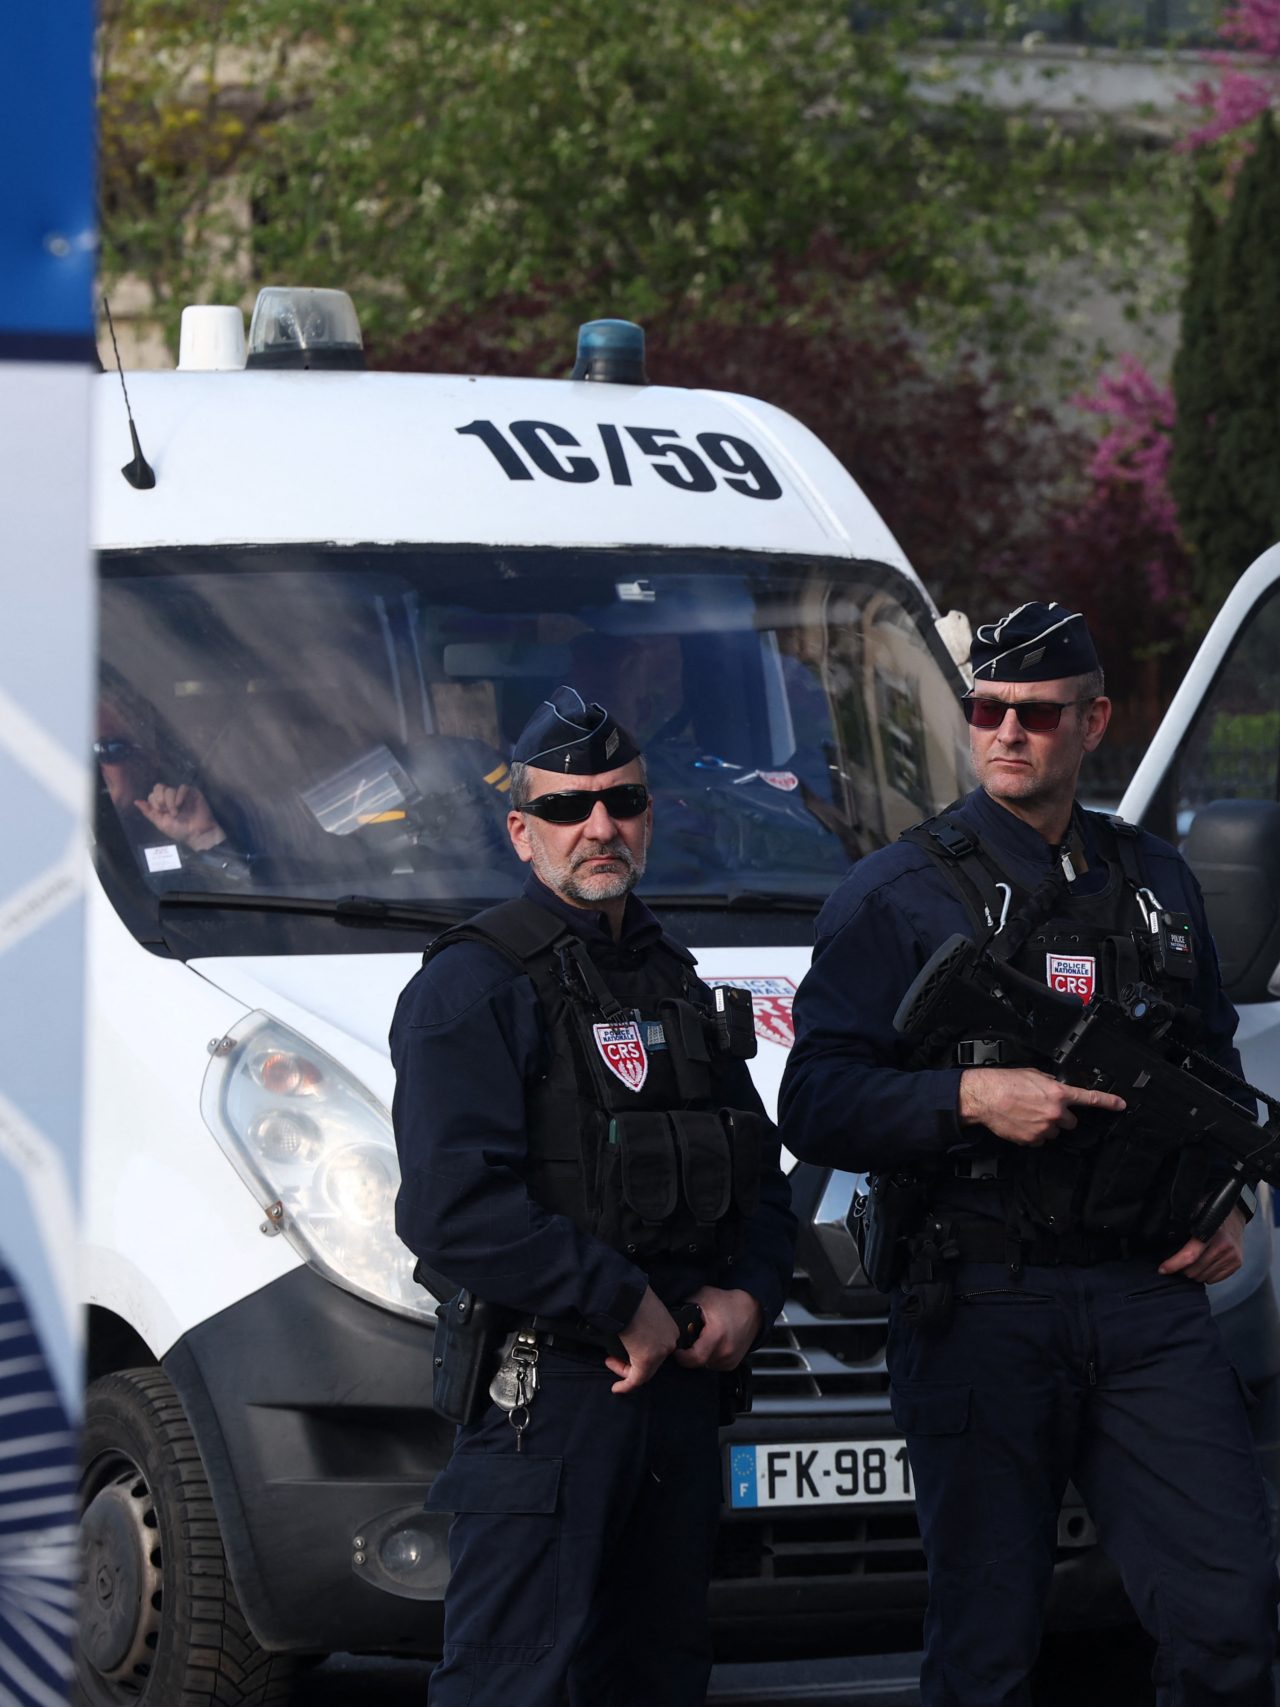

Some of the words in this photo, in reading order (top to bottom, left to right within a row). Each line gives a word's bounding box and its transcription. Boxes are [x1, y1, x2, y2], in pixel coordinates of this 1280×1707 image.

[455, 420, 782, 500] 1C/59
[1171, 934, 1184, 943] POLICE
[1055, 967, 1089, 975] NATIONALE
[706, 980, 779, 988] OLICE
[1055, 976, 1088, 994] CRS
[607, 1043, 639, 1060] CRS
[767, 1446, 911, 1499] FK-981
[739, 1483, 749, 1497] F
